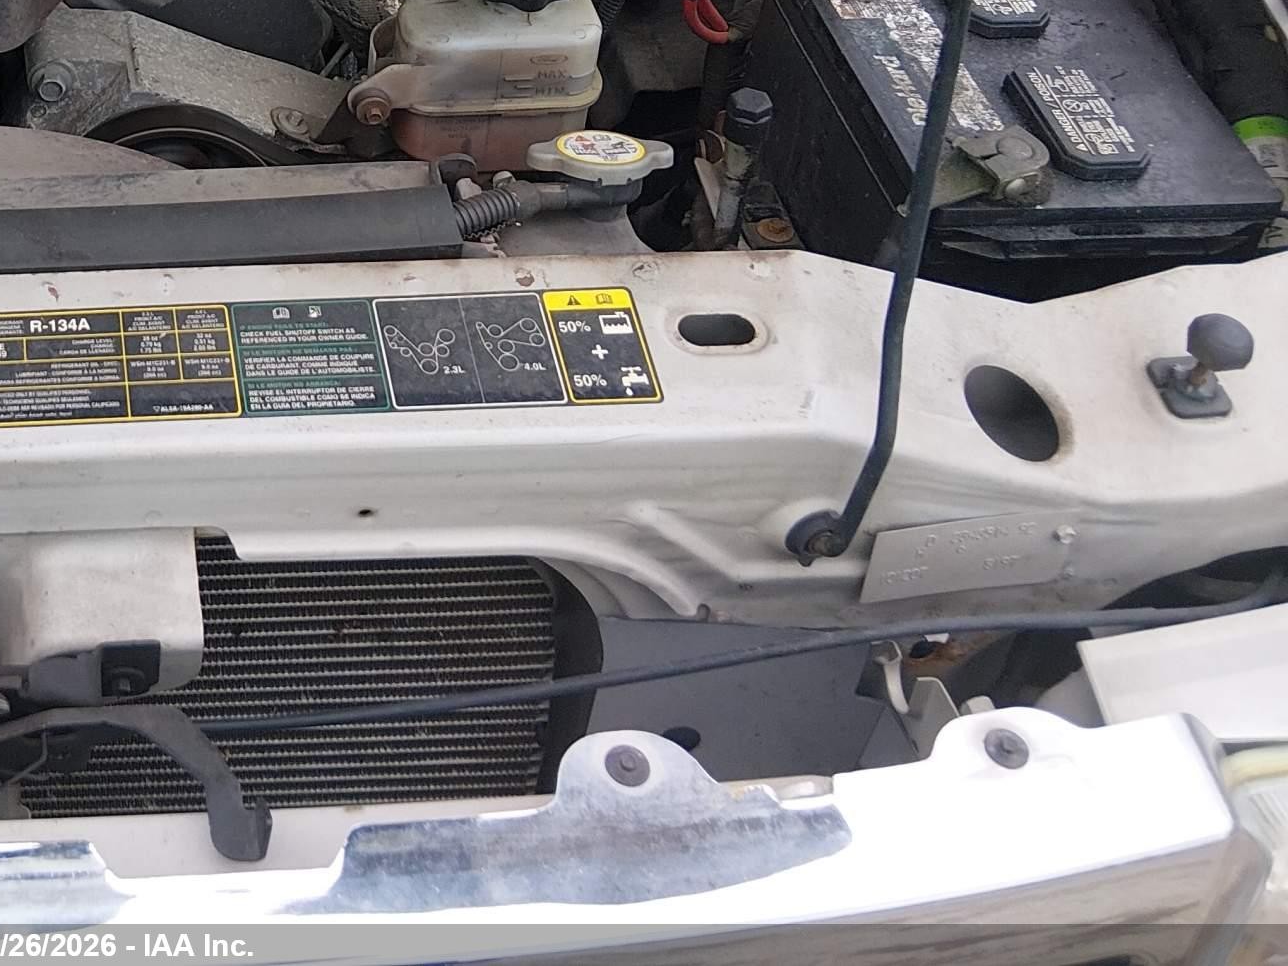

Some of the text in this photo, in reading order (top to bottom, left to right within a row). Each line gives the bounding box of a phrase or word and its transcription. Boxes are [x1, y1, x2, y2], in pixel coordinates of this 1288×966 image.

[1027, 72, 1054, 101] POISON
[1052, 109, 1083, 143] DANGER
[30, 318, 90, 333] R-134A
[558, 320, 591, 333] 50%
[241, 336, 287, 344] REFERENCED
[443, 365, 465, 374] 2.3L
[524, 362, 546, 371] 4.0L
[573, 374, 607, 387] 50%
[286, 387, 335, 395] INTERRUPTOR
